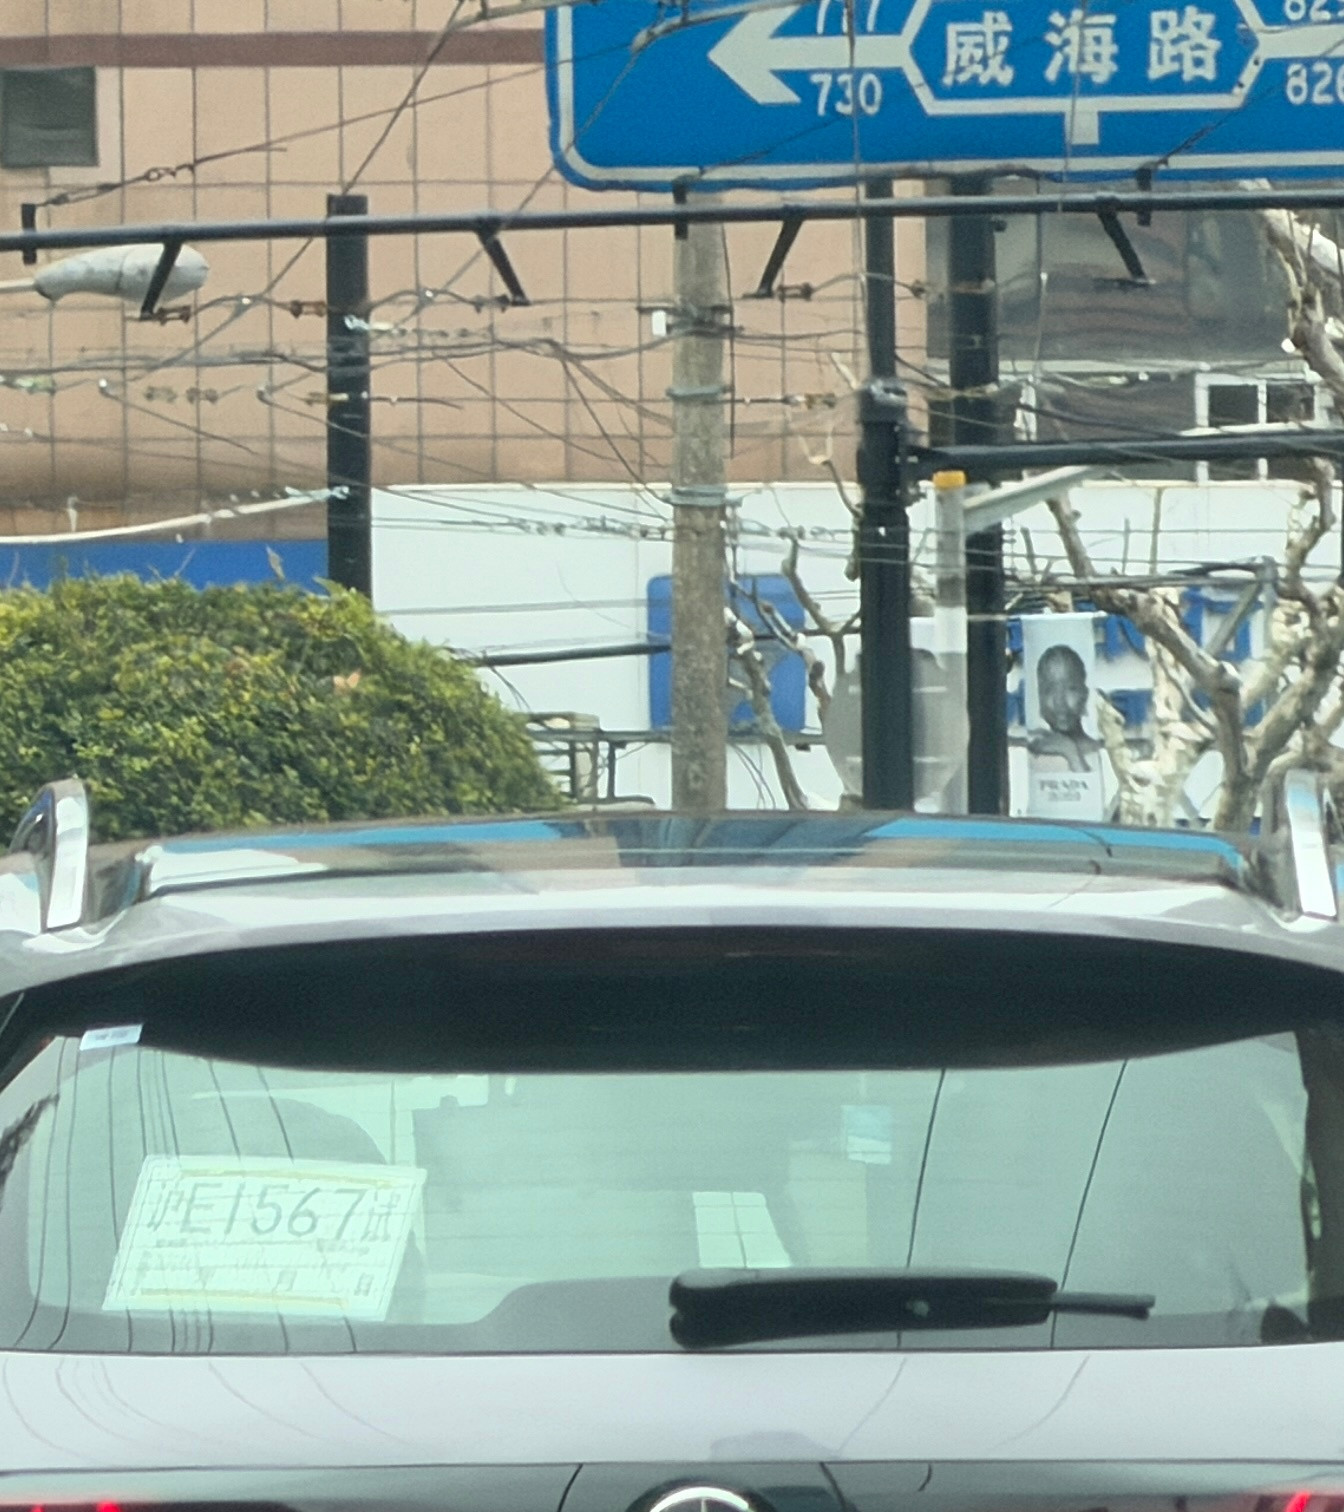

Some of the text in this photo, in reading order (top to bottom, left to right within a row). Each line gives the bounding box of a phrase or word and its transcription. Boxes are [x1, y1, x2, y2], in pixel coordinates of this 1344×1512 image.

[942, 5, 1222, 87] 威海路
[810, 73, 882, 116] 730
